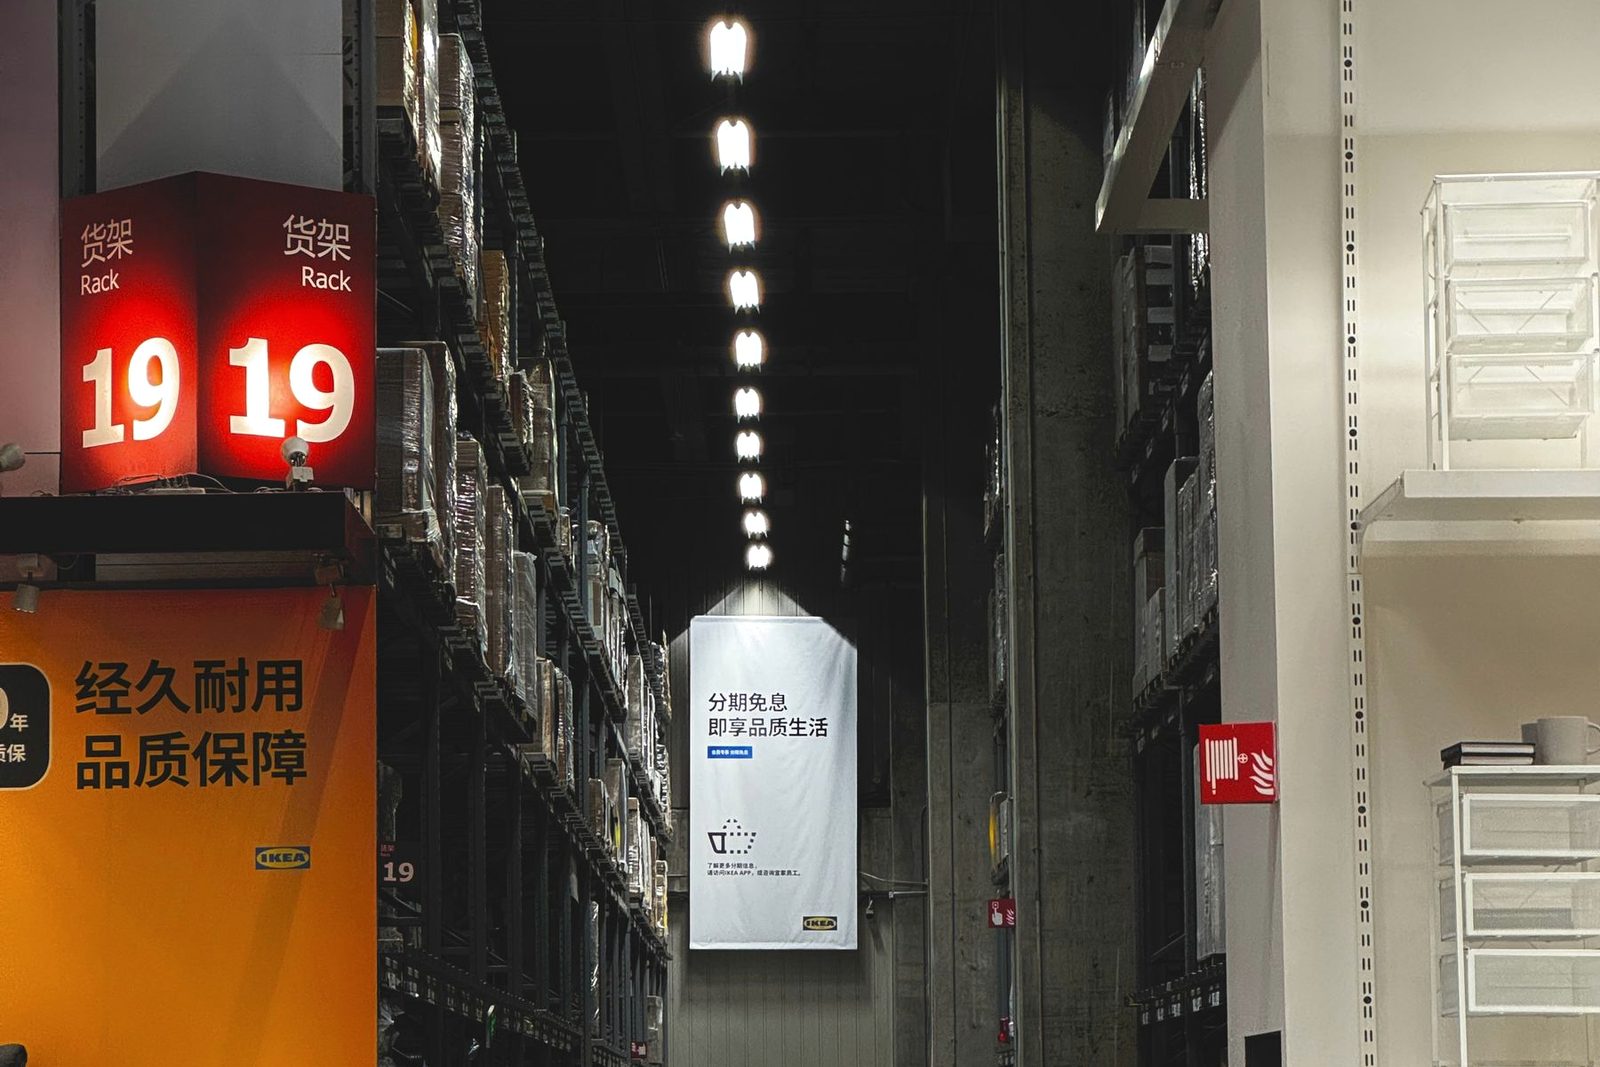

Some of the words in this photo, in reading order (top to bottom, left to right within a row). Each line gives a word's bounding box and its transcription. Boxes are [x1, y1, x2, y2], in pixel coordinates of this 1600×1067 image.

[81, 218, 134, 268] 货架
[282, 213, 352, 262] 货架
[81, 269, 120, 296] Rack
[301, 266, 352, 292] Rack
[82, 336, 181, 449] 19
[229, 336, 355, 443] 19
[75, 657, 304, 715] 经久耐用
[708, 692, 788, 712] 分期免息
[708, 717, 828, 737] 即享品质生活
[76, 729, 308, 789] 品质保障
[260, 852, 306, 863] IKEA
[383, 862, 414, 882] 19
